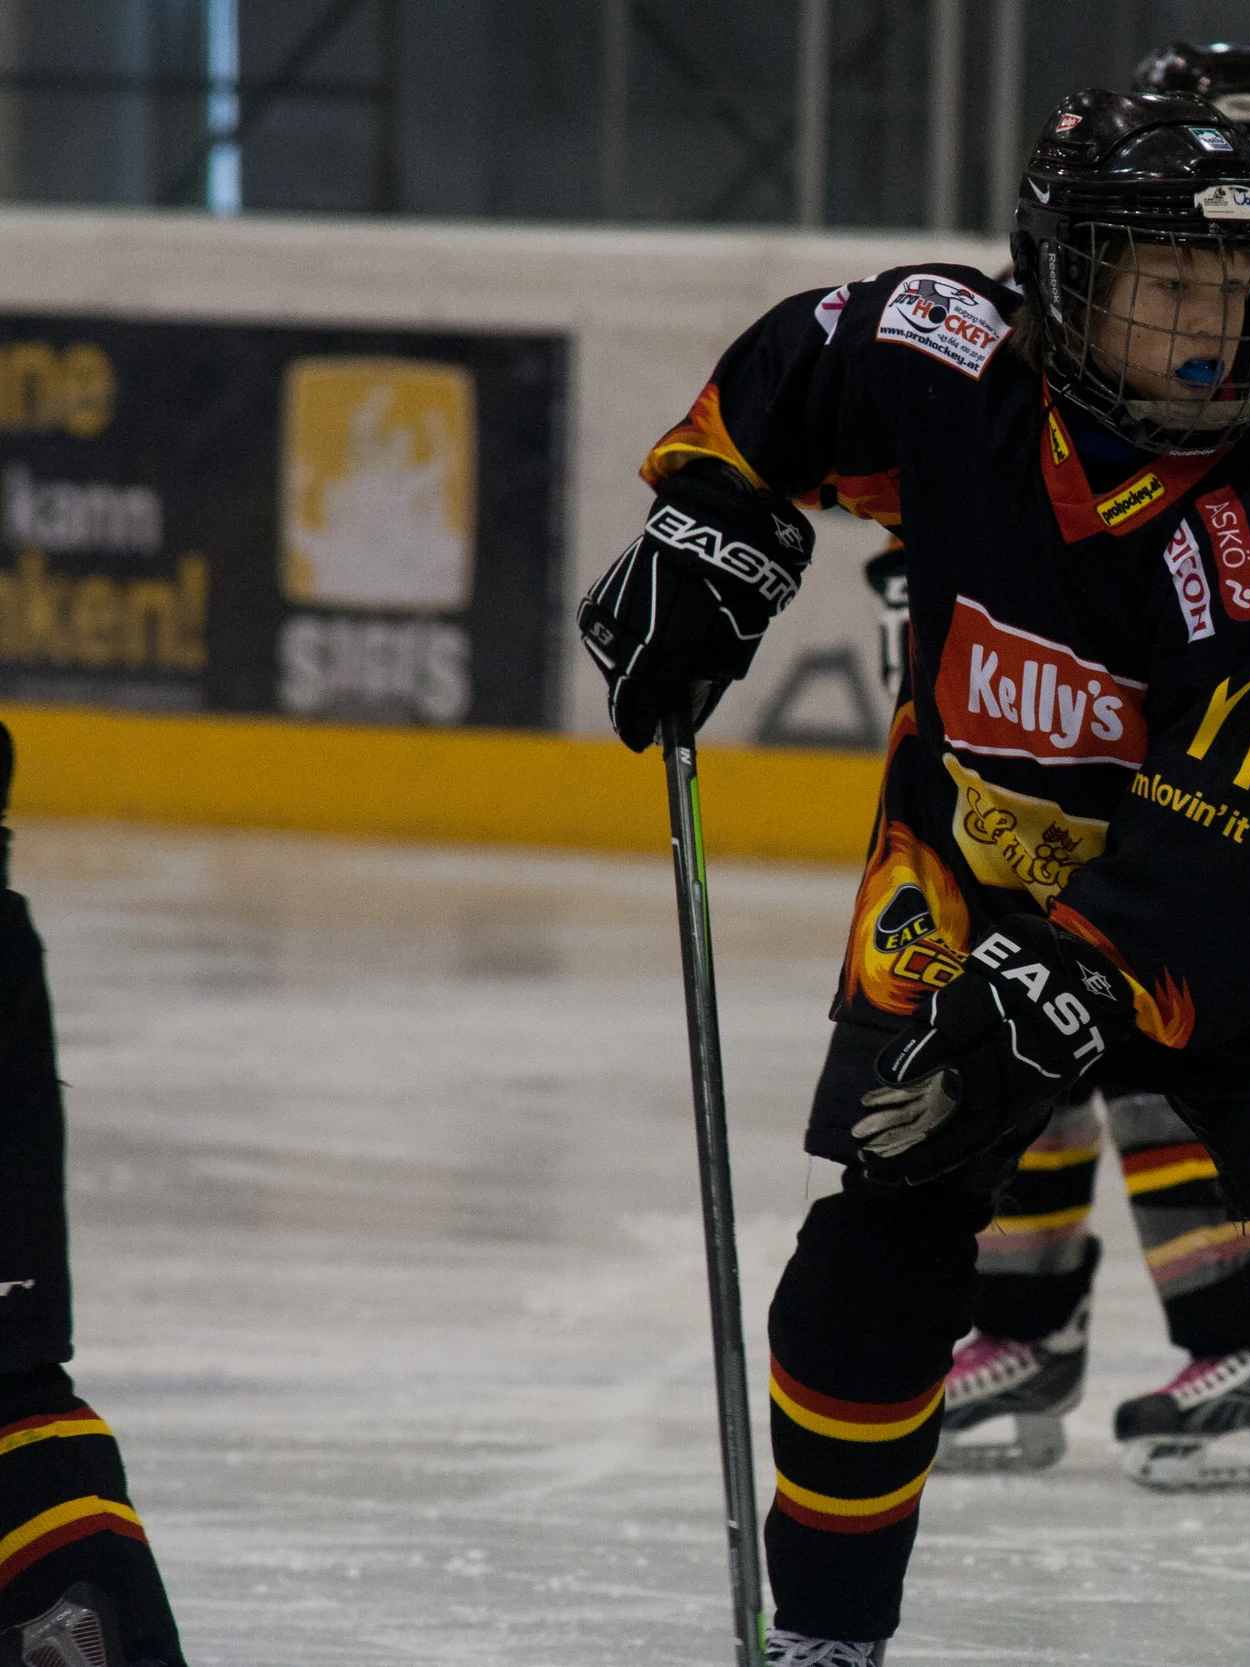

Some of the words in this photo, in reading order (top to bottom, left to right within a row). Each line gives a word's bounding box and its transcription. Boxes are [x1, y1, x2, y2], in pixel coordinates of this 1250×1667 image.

[1048, 253, 1060, 304] Reebok
[1205, 501, 1250, 569] ASKÖ
[967, 643, 1124, 750] Kelly's
[1222, 809, 1250, 844] it
[886, 917, 928, 949] EAC
